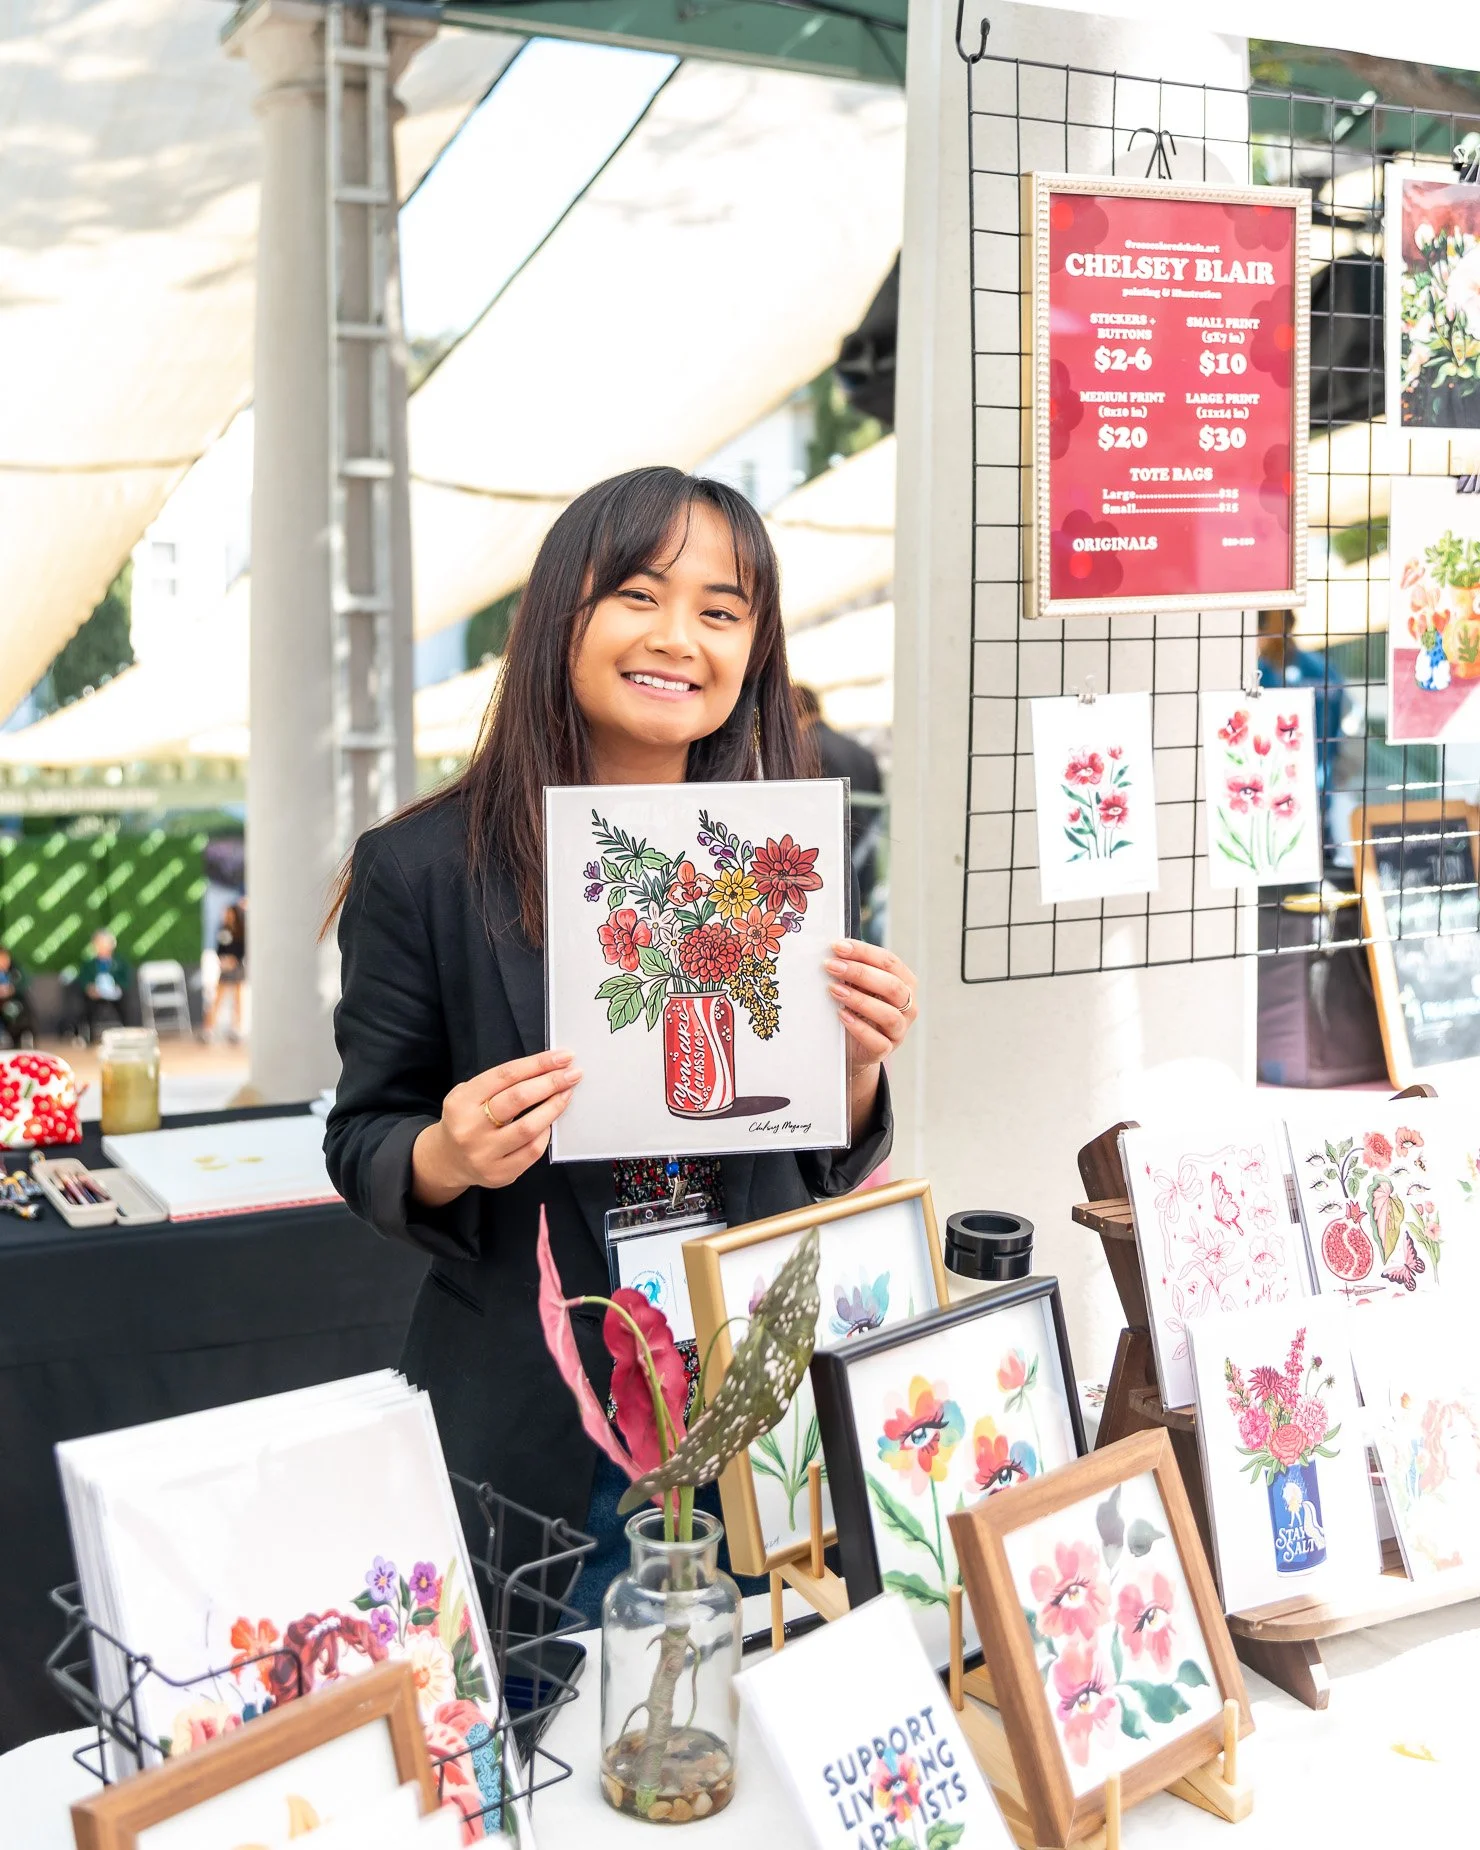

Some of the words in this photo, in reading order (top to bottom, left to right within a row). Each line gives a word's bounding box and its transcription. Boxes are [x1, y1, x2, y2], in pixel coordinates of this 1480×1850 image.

[1065, 252, 1190, 281] CHELSEY
[1194, 258, 1276, 285] BLAIR
[1122, 286, 1161, 299] painting
[1161, 287, 1171, 297] &
[1171, 288, 1222, 300] illustration
[1089, 312, 1148, 326] STICKERS
[1186, 316, 1225, 329] SMALL
[1225, 318, 1261, 331] PRINT
[1097, 328, 1153, 340] BUTTONS
[1229, 331, 1246, 345] in)
[1094, 345, 1153, 373] $2-6
[1199, 349, 1248, 377] $10
[1080, 391, 1128, 404] MEDIUM
[1129, 391, 1166, 404] PRINT
[1185, 392, 1224, 405] LARGE
[1225, 393, 1261, 406] PRINT
[1098, 405, 1130, 419] (8x10
[1130, 405, 1148, 419] in)
[1196, 406, 1233, 420] (11x14
[1234, 407, 1250, 420] in)
[1098, 423, 1149, 451] $20
[1199, 424, 1248, 452] $30
[1129, 467, 1170, 482] TOTE
[1172, 467, 1214, 482] BAGS
[1072, 536, 1159, 552] ORIGINALS
[692, 1035, 705, 1090] CLASSIC
[673, 1054, 704, 1108] You
[1275, 1526, 1307, 1549] STAY
[822, 1705, 936, 1797] SUPPORT
